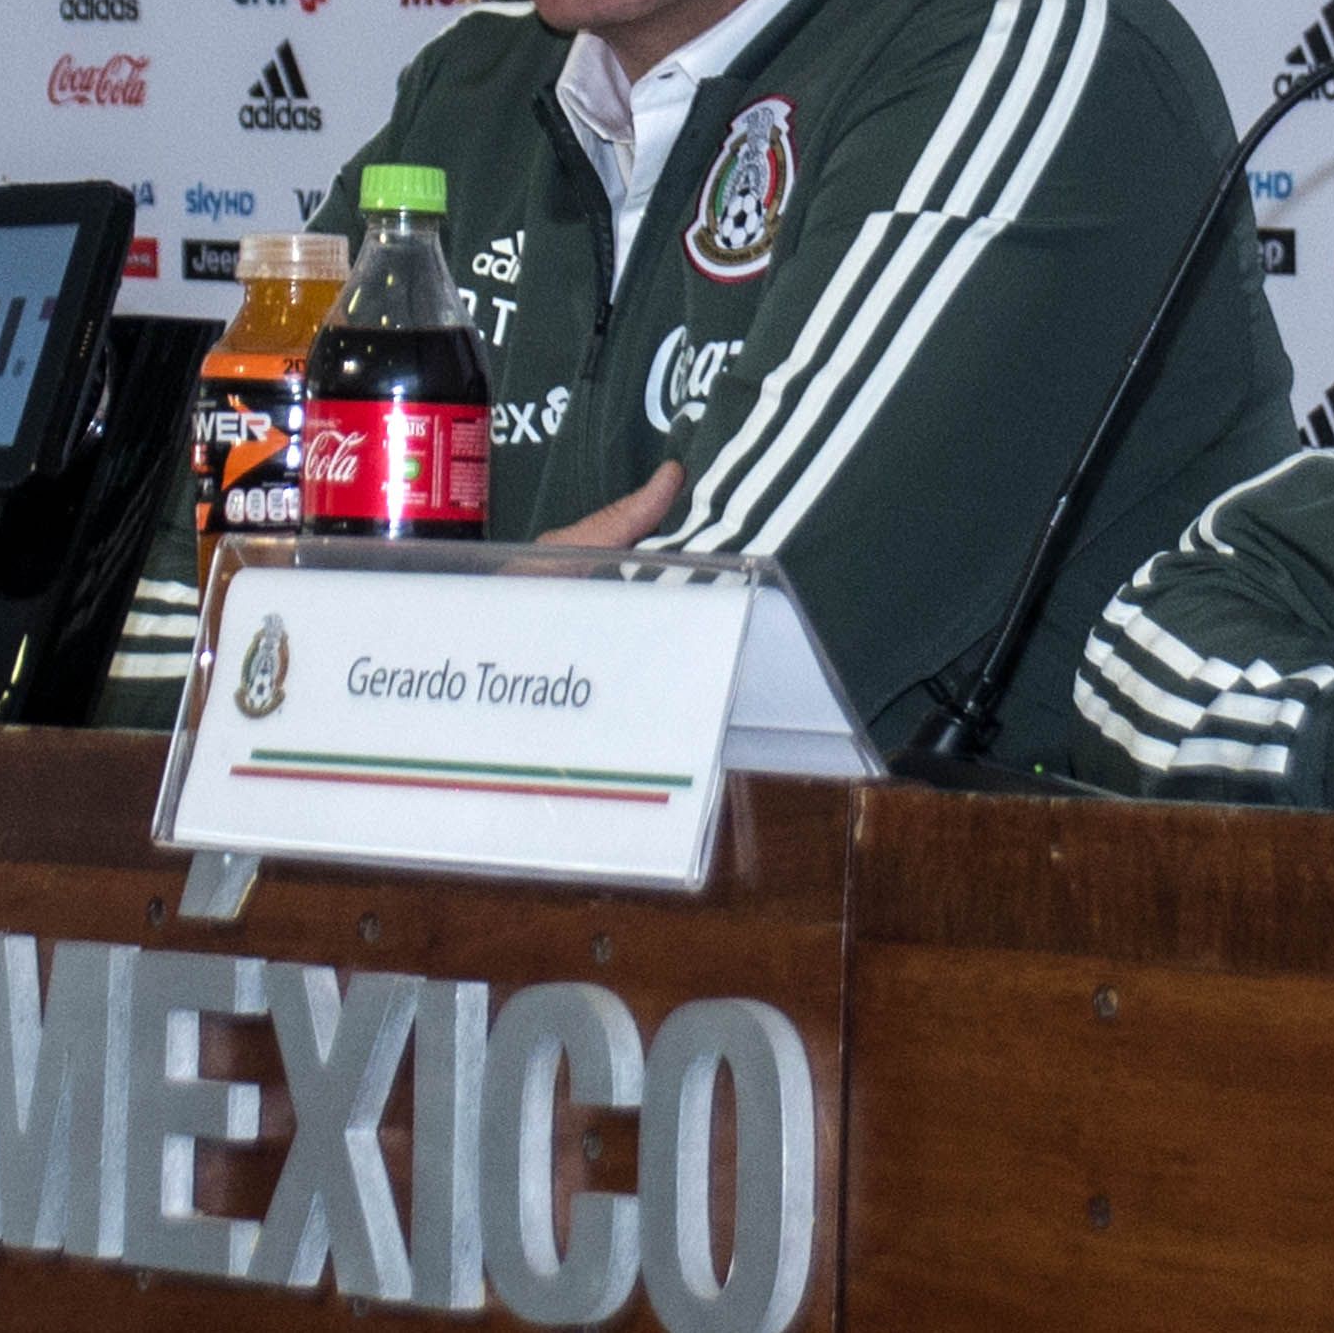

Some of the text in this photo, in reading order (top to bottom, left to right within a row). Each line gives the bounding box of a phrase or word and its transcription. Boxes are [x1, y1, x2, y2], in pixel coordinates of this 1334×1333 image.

[239, 98, 323, 132] adidas
[347, 655, 591, 708] Gerardo Torrado
